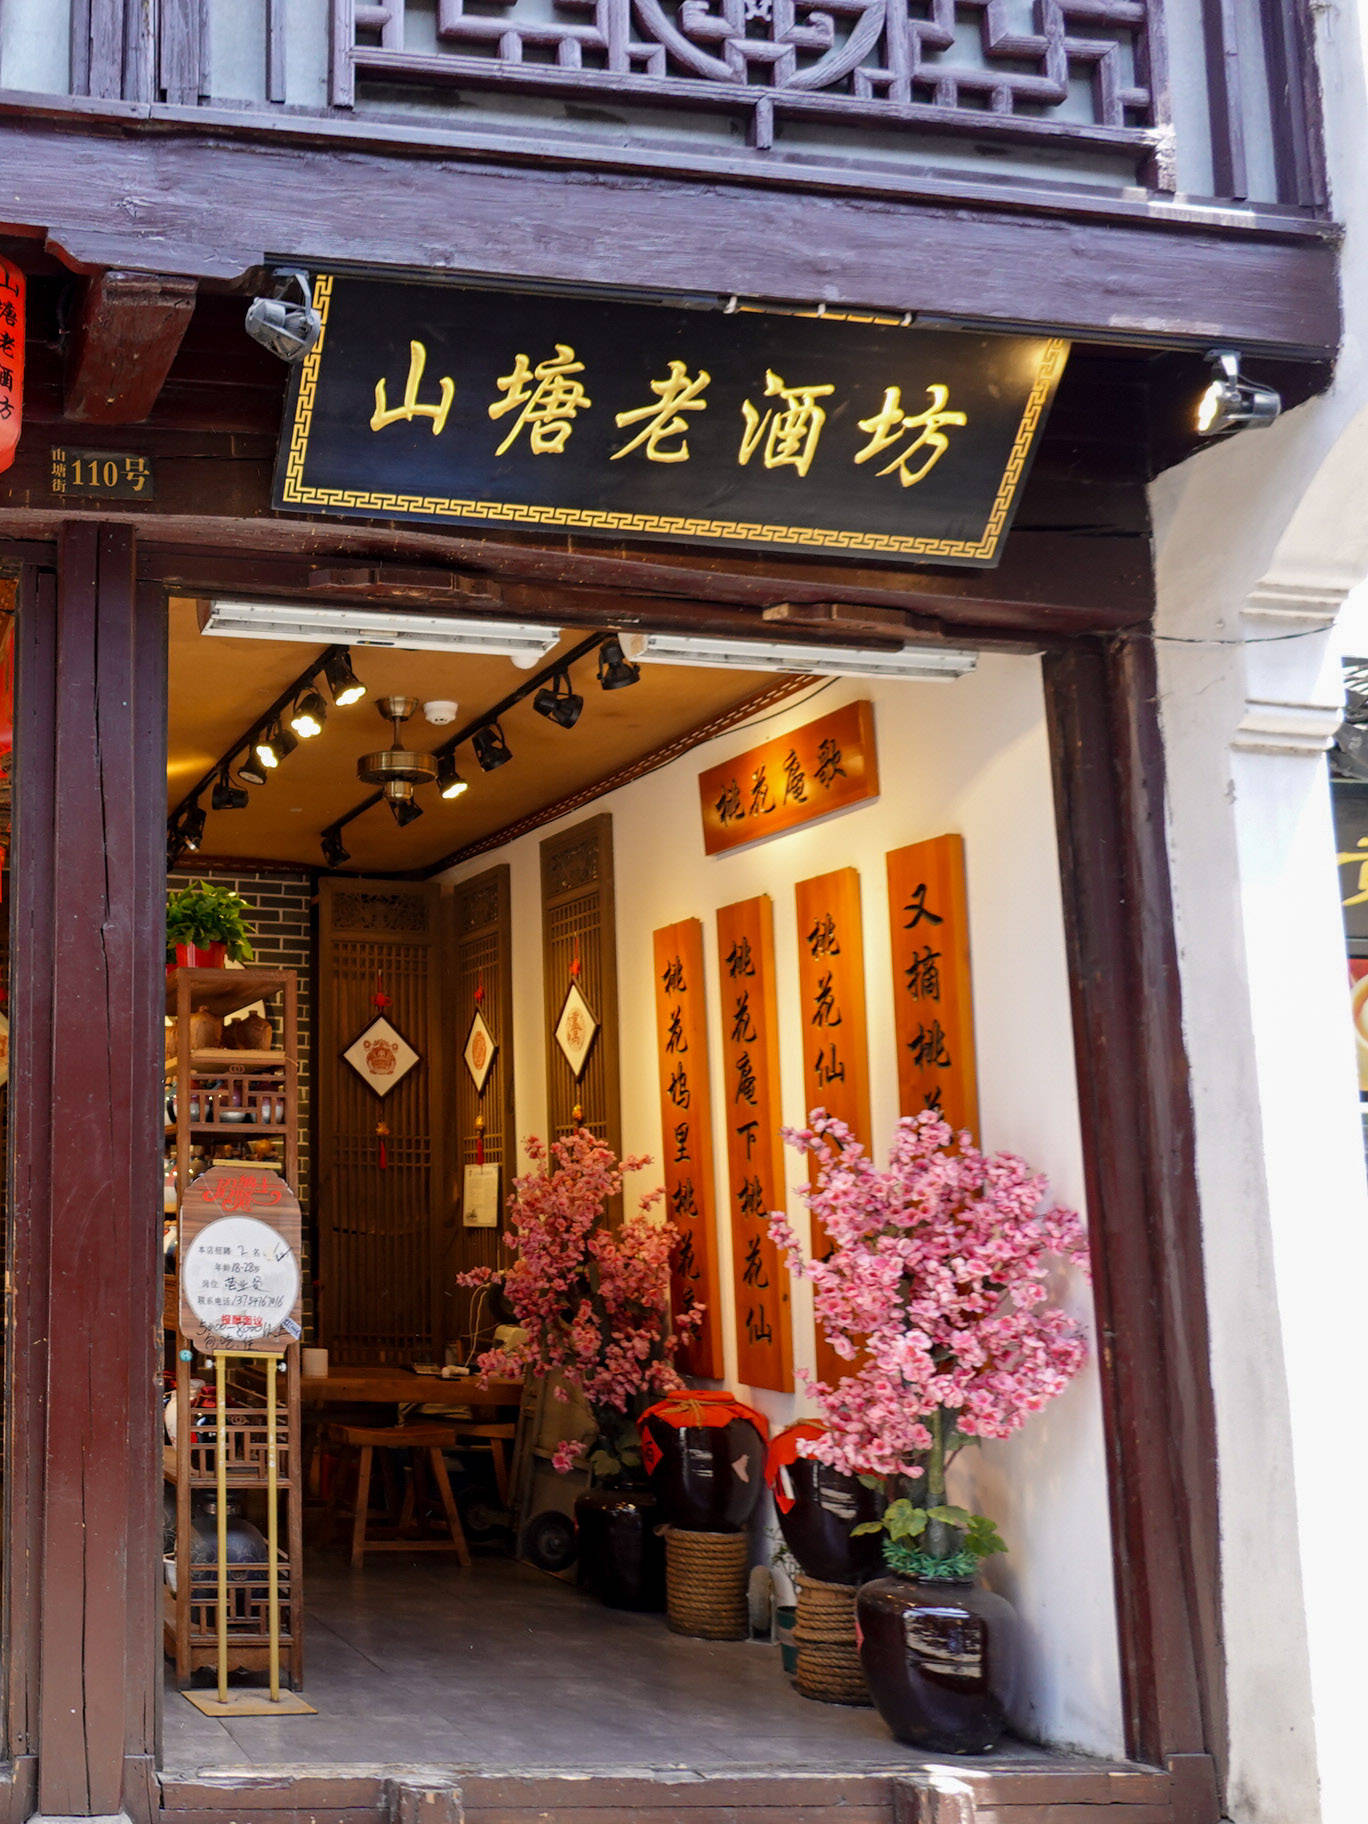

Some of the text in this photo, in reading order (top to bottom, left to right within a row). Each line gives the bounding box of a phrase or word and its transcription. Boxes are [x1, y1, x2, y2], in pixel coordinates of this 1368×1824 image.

[370, 339, 969, 489] 山塘老酒坊
[52, 448, 67, 493] 山塘街
[71, 457, 151, 491] 110号
[715, 738, 848, 828] 桃花庵歌
[725, 936, 773, 1346] 桃花庵下桃花仙
